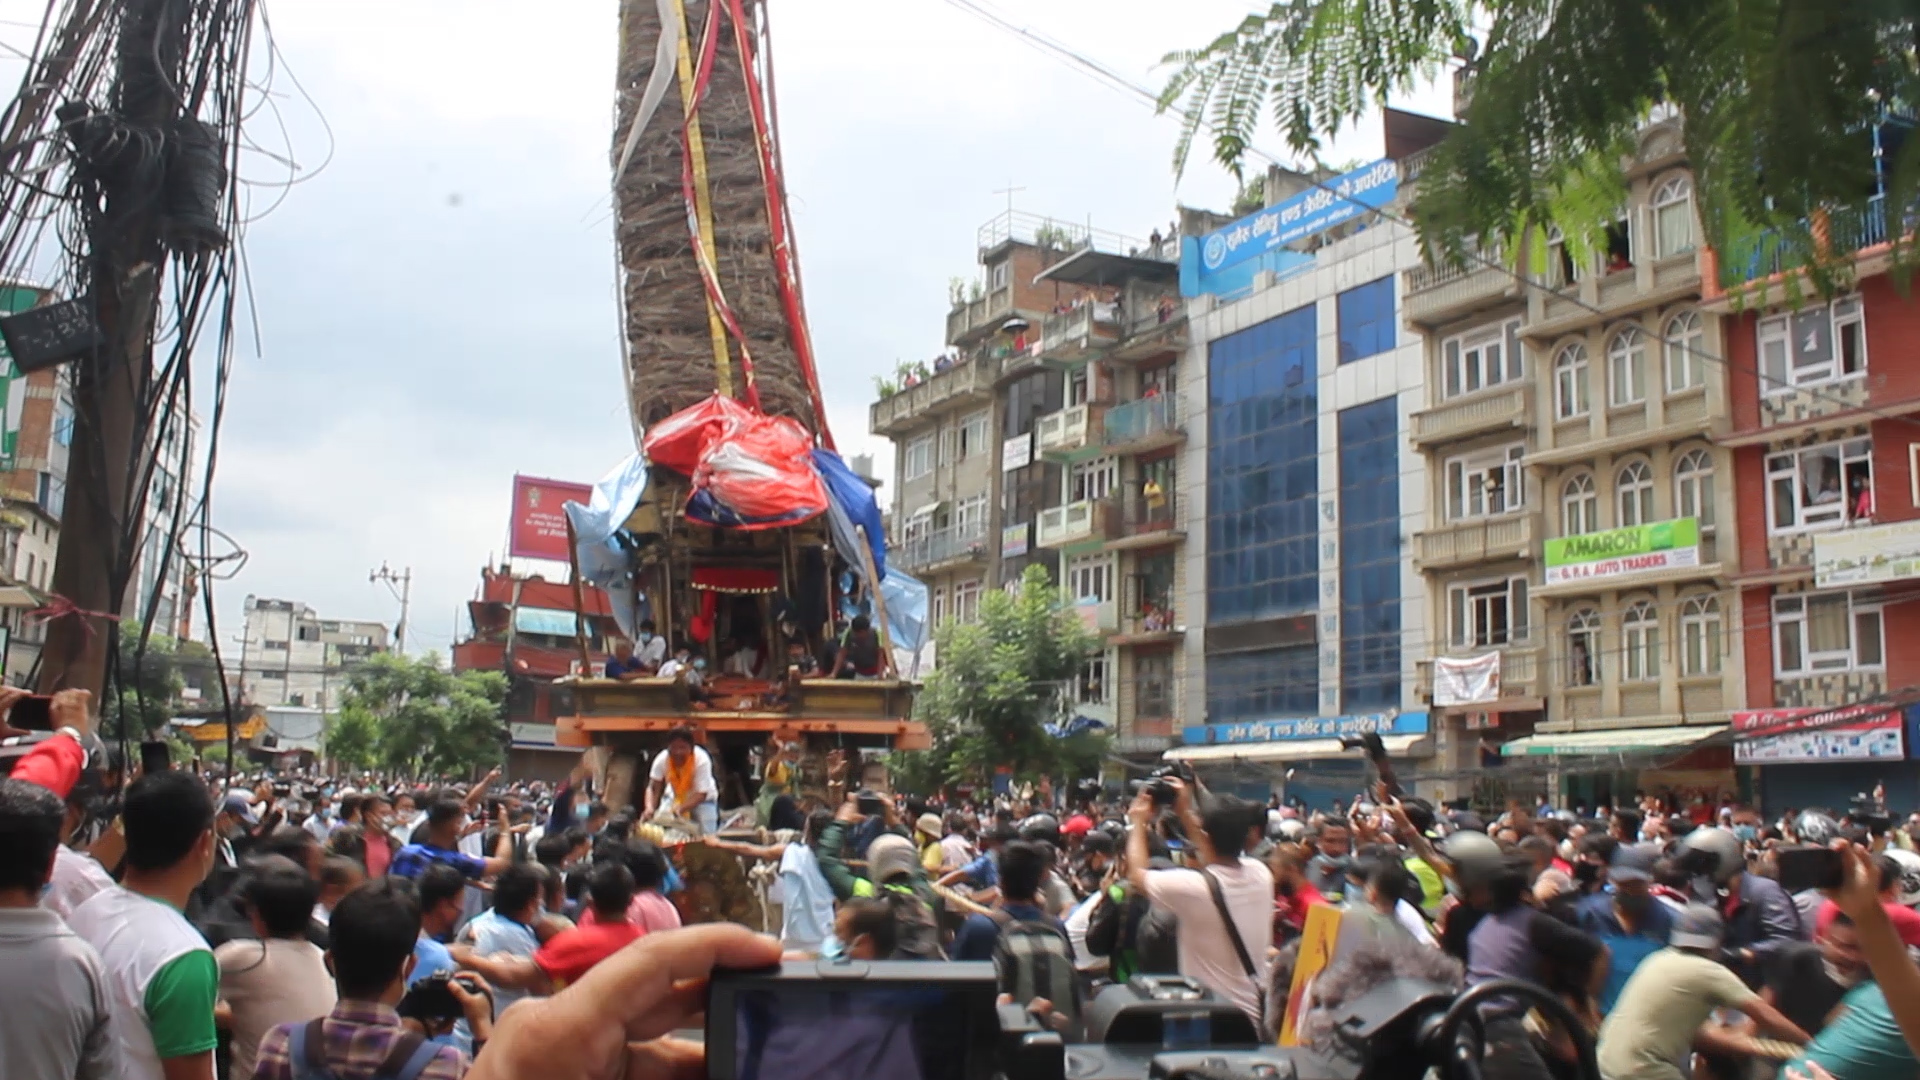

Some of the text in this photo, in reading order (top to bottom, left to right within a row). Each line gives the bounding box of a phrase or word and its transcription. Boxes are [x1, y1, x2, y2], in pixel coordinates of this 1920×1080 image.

[1563, 529, 1641, 559] AMARON
[1594, 560, 1620, 576] AUTO
[1621, 553, 1668, 571] TRADERS
